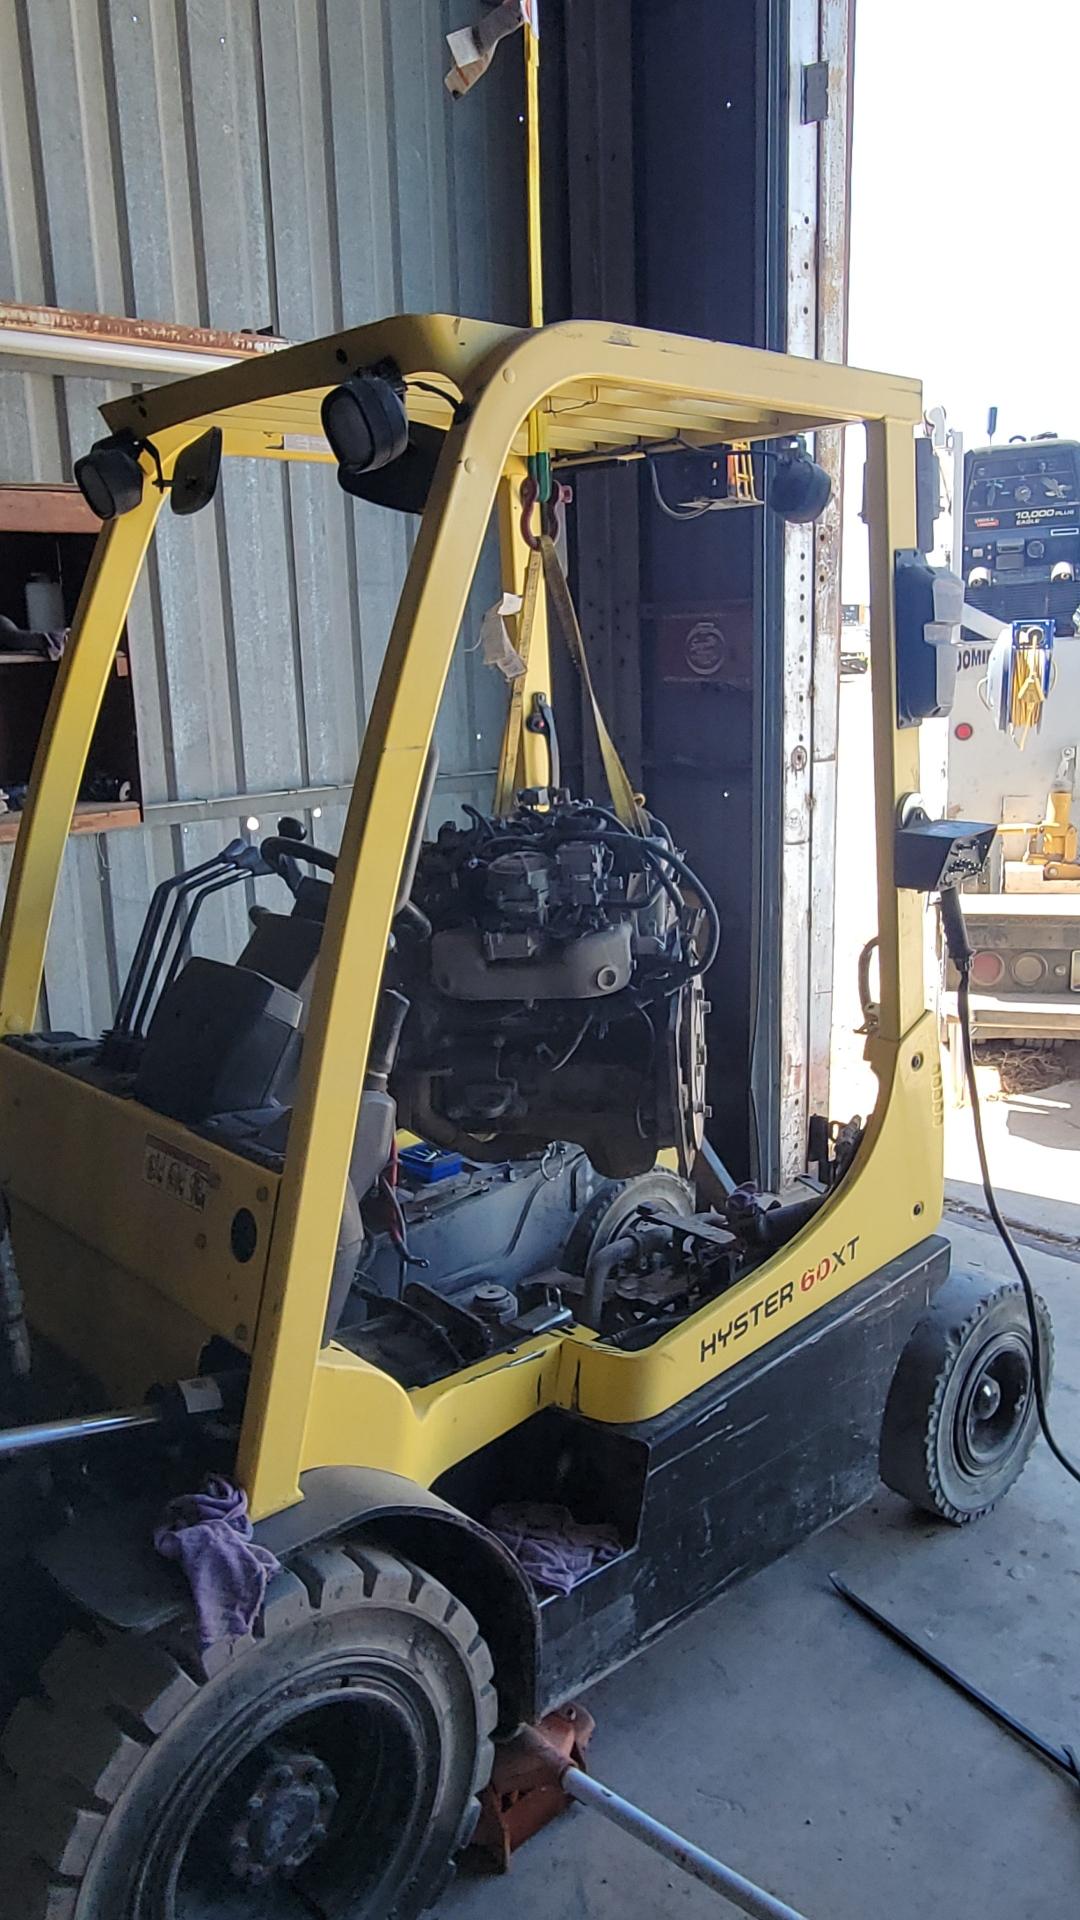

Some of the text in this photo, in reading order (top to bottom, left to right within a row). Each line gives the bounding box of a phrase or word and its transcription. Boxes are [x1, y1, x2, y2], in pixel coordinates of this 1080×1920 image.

[1016, 509, 1055, 519] 10,000
[700, 1236, 859, 1362] HYSTER 60XT
